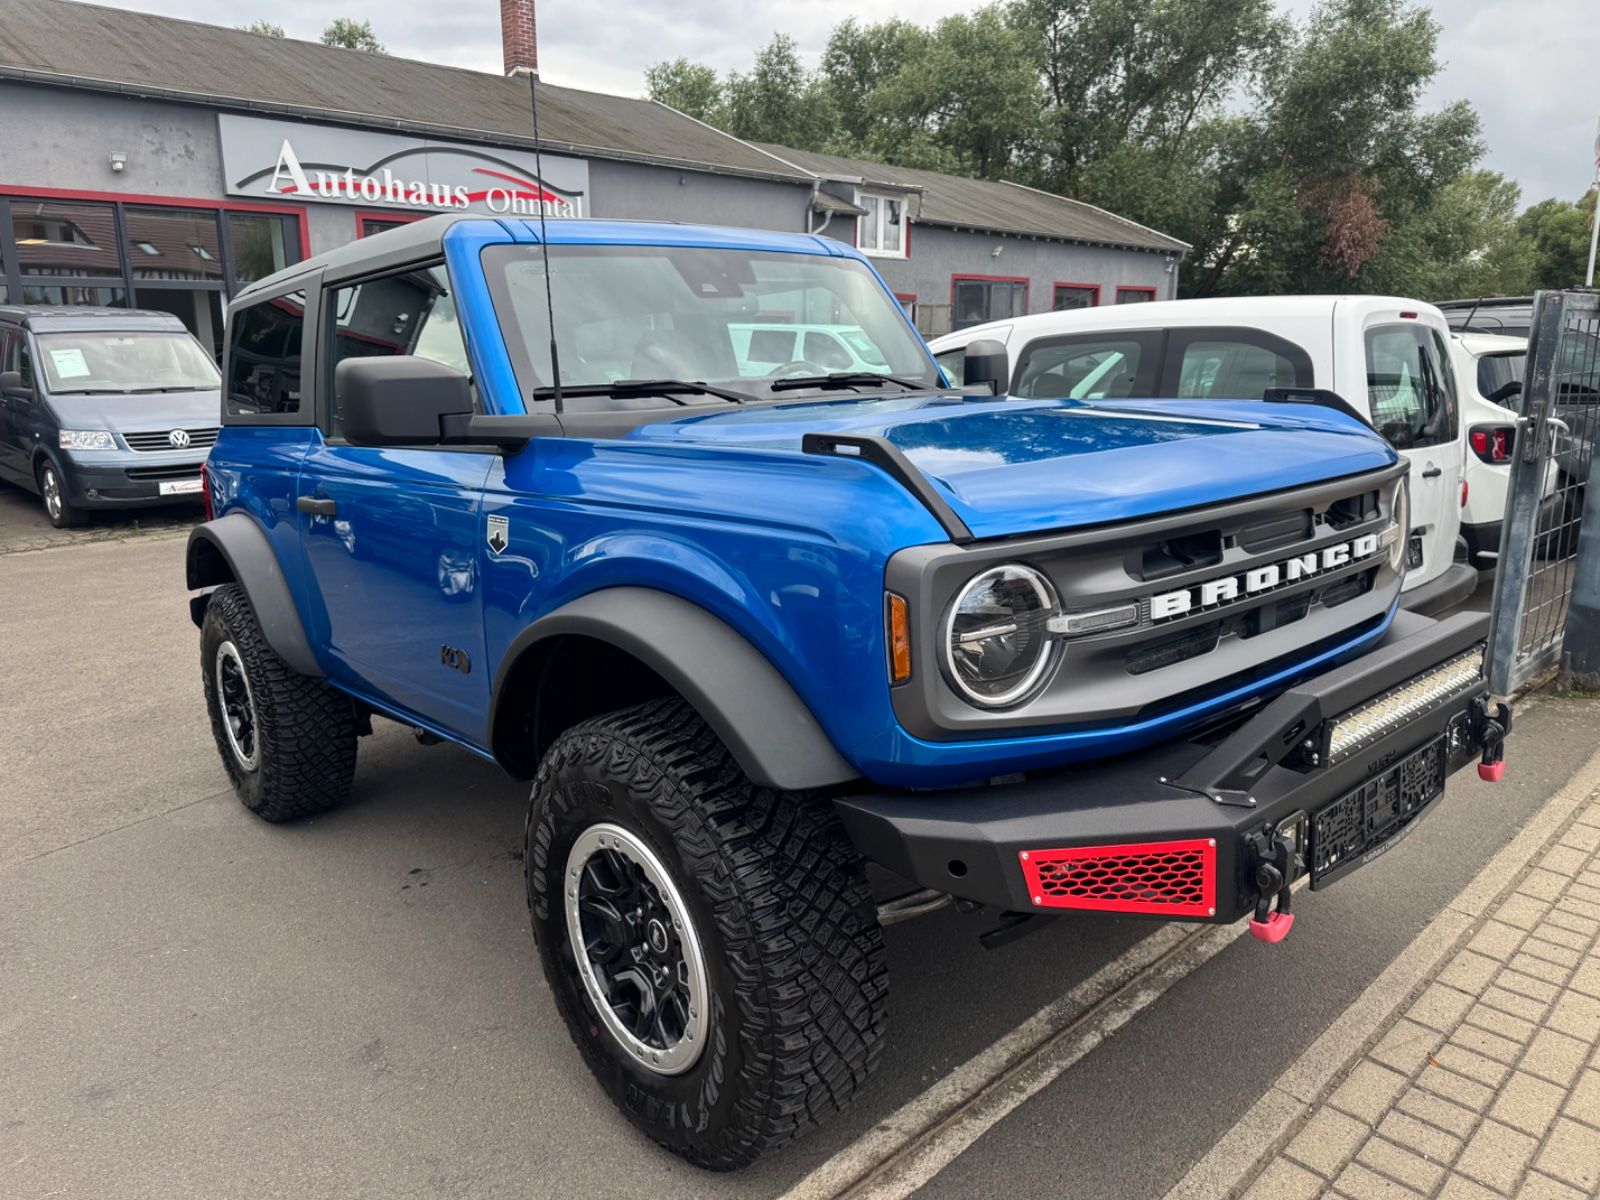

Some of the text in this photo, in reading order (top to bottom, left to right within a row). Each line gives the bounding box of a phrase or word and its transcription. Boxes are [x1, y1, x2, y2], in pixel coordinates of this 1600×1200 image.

[265, 138, 583, 219] Autohaus Ohmtal
[1151, 533, 1377, 620] BRONCO
